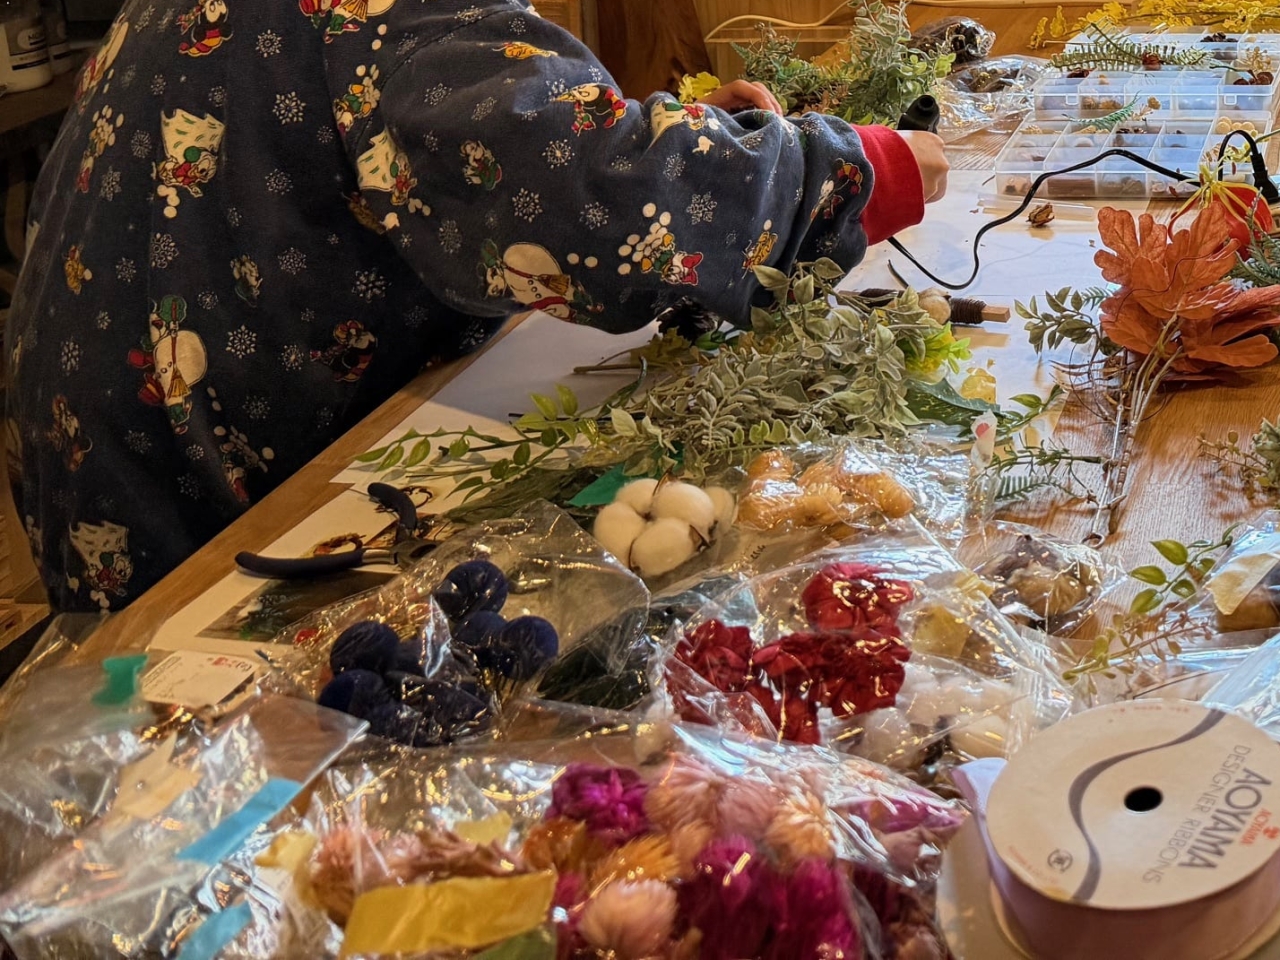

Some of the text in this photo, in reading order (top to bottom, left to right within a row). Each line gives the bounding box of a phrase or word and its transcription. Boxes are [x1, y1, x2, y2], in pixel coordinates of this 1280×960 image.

[1142, 744, 1252, 884] DESIGNER RIBBONS
[1177, 767, 1272, 869] AOYAMA
